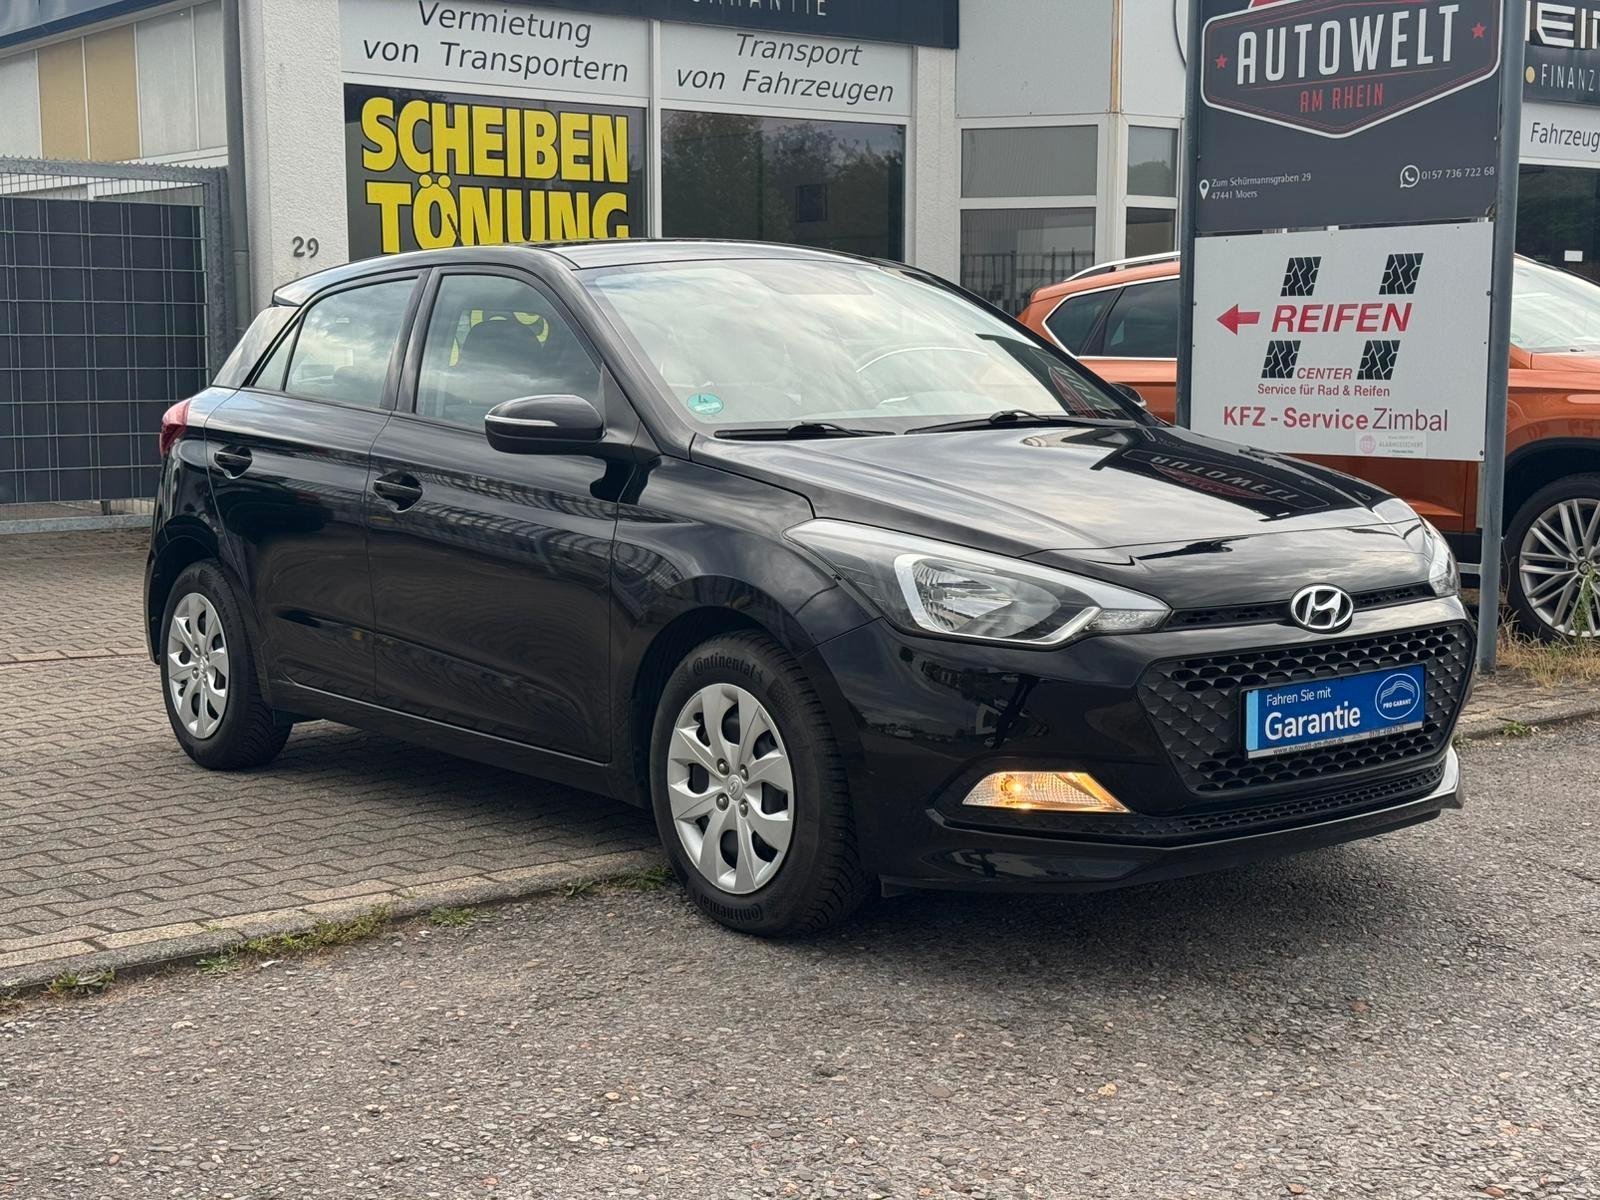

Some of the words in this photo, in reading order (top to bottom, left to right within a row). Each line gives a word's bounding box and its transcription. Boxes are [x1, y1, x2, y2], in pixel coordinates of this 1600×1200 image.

[418, 0, 592, 48] Vermietung
[736, 33, 862, 68] Transport
[1237, 4, 1460, 85] AUTOWELT
[363, 40, 419, 63] von
[440, 41, 628, 82] Transportern
[676, 68, 726, 90] von
[742, 69, 894, 105] Fahrzeugen
[1541, 63, 1600, 92] FINANZ
[1300, 91, 1323, 113] AM
[1332, 83, 1384, 110] RHEIN
[361, 97, 629, 184] SCHEIBEN
[1530, 122, 1600, 152] Fahrzeug
[1211, 179, 1228, 188] Zum
[1230, 173, 1299, 186] Schürmannsgraben
[1302, 172, 1311, 182] 29
[1421, 170, 1442, 180] 0157
[1446, 169, 1462, 178] 736
[1465, 167, 1481, 177] 722
[1484, 166, 1495, 175] 68
[1211, 190, 1232, 200] 47441
[1235, 189, 1258, 199] Moers
[365, 174, 629, 254] TÖNUNG
[291, 235, 320, 258] 29
[1271, 303, 1412, 332] REIFEN
[1296, 367, 1353, 381] CENTER
[1257, 383, 1296, 396] Service
[1299, 384, 1315, 396] für
[1317, 384, 1340, 397] Rad
[1343, 385, 1350, 396] &
[1354, 385, 1390, 397] Reifen
[1224, 406, 1266, 427] KFZ
[1283, 407, 1369, 430] Service
[1373, 407, 1448, 431] Zimbal
[1266, 692, 1298, 707] Fahren
[1300, 690, 1315, 702] Sie
[1317, 686, 1331, 699] mit
[1393, 698, 1412, 708] GARANT
[1265, 700, 1361, 741] Garantie
